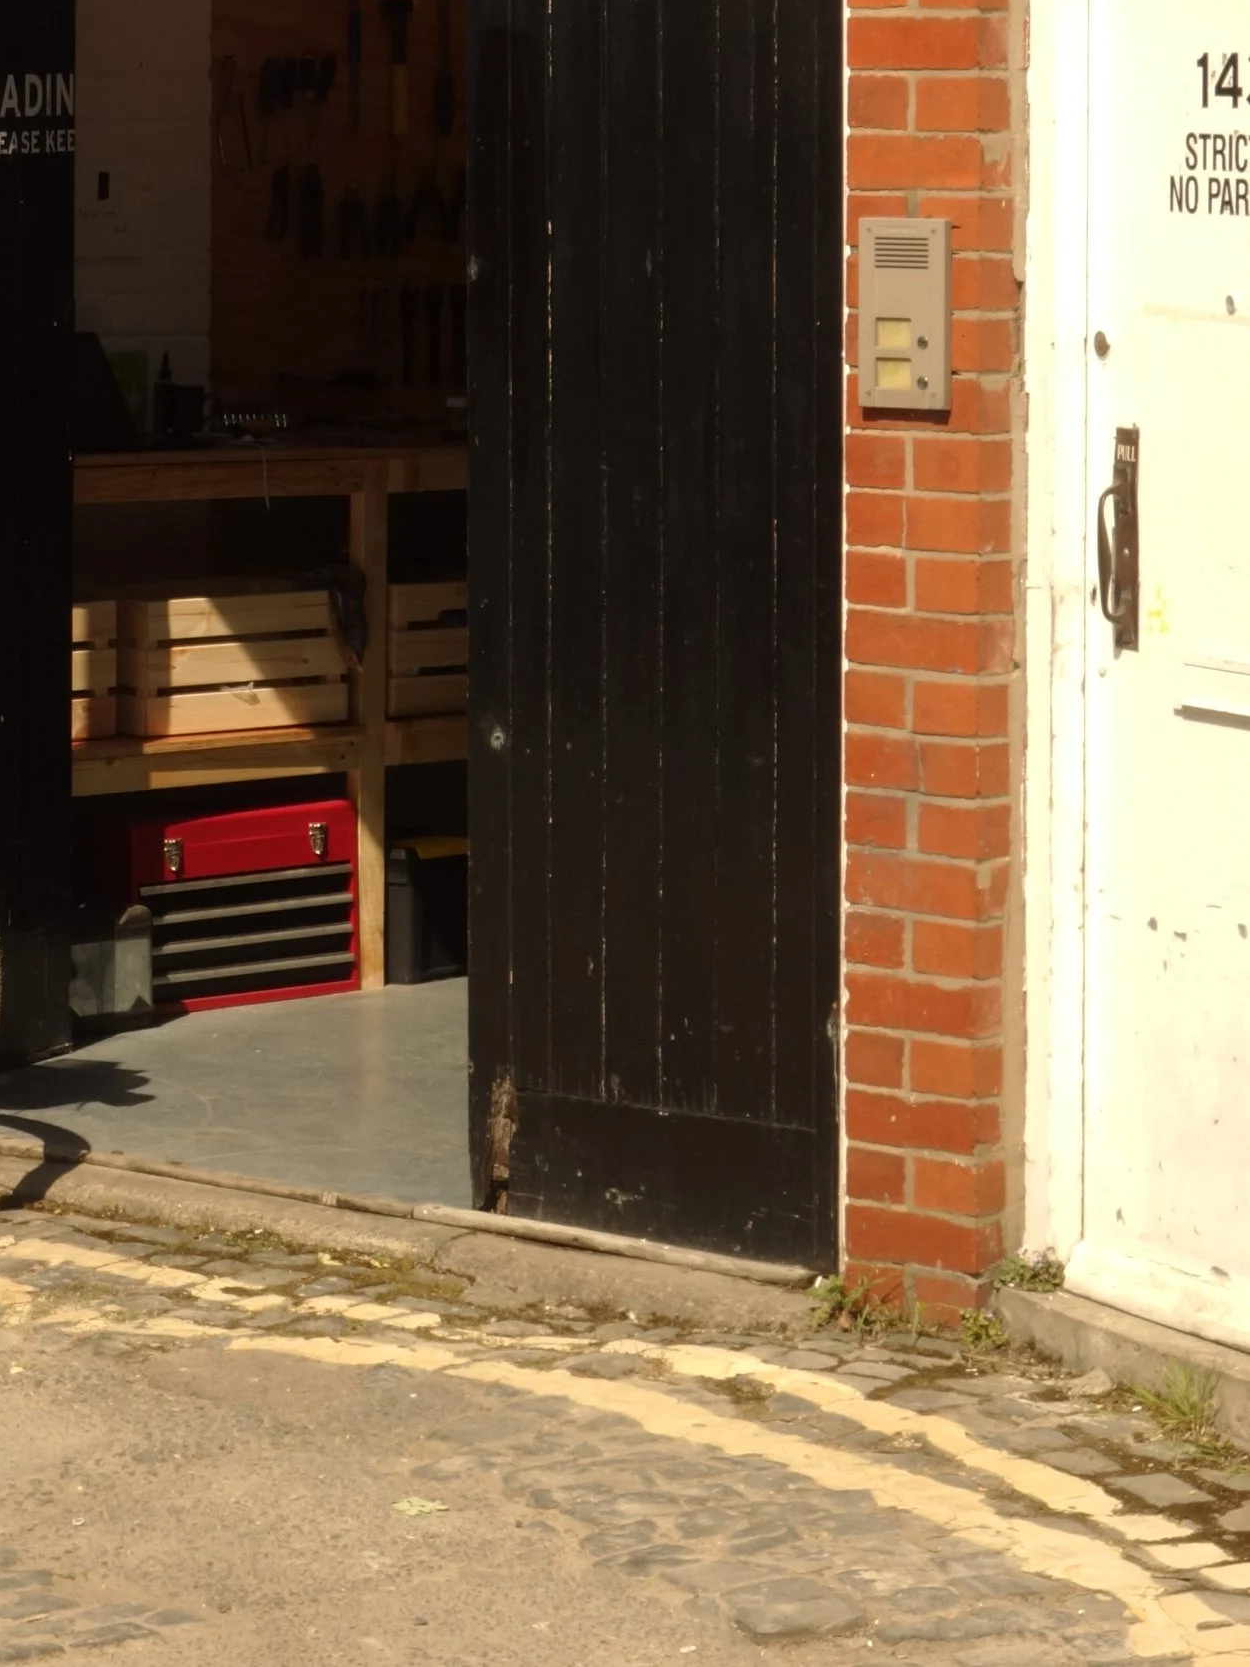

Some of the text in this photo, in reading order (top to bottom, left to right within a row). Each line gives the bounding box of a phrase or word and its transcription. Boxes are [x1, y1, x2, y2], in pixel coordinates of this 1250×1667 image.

[1197, 52, 1250, 108] 14
[1185, 132, 1250, 173] STRIC
[1170, 175, 1250, 216] NO PAR
[1117, 444, 1136, 462] PULL
